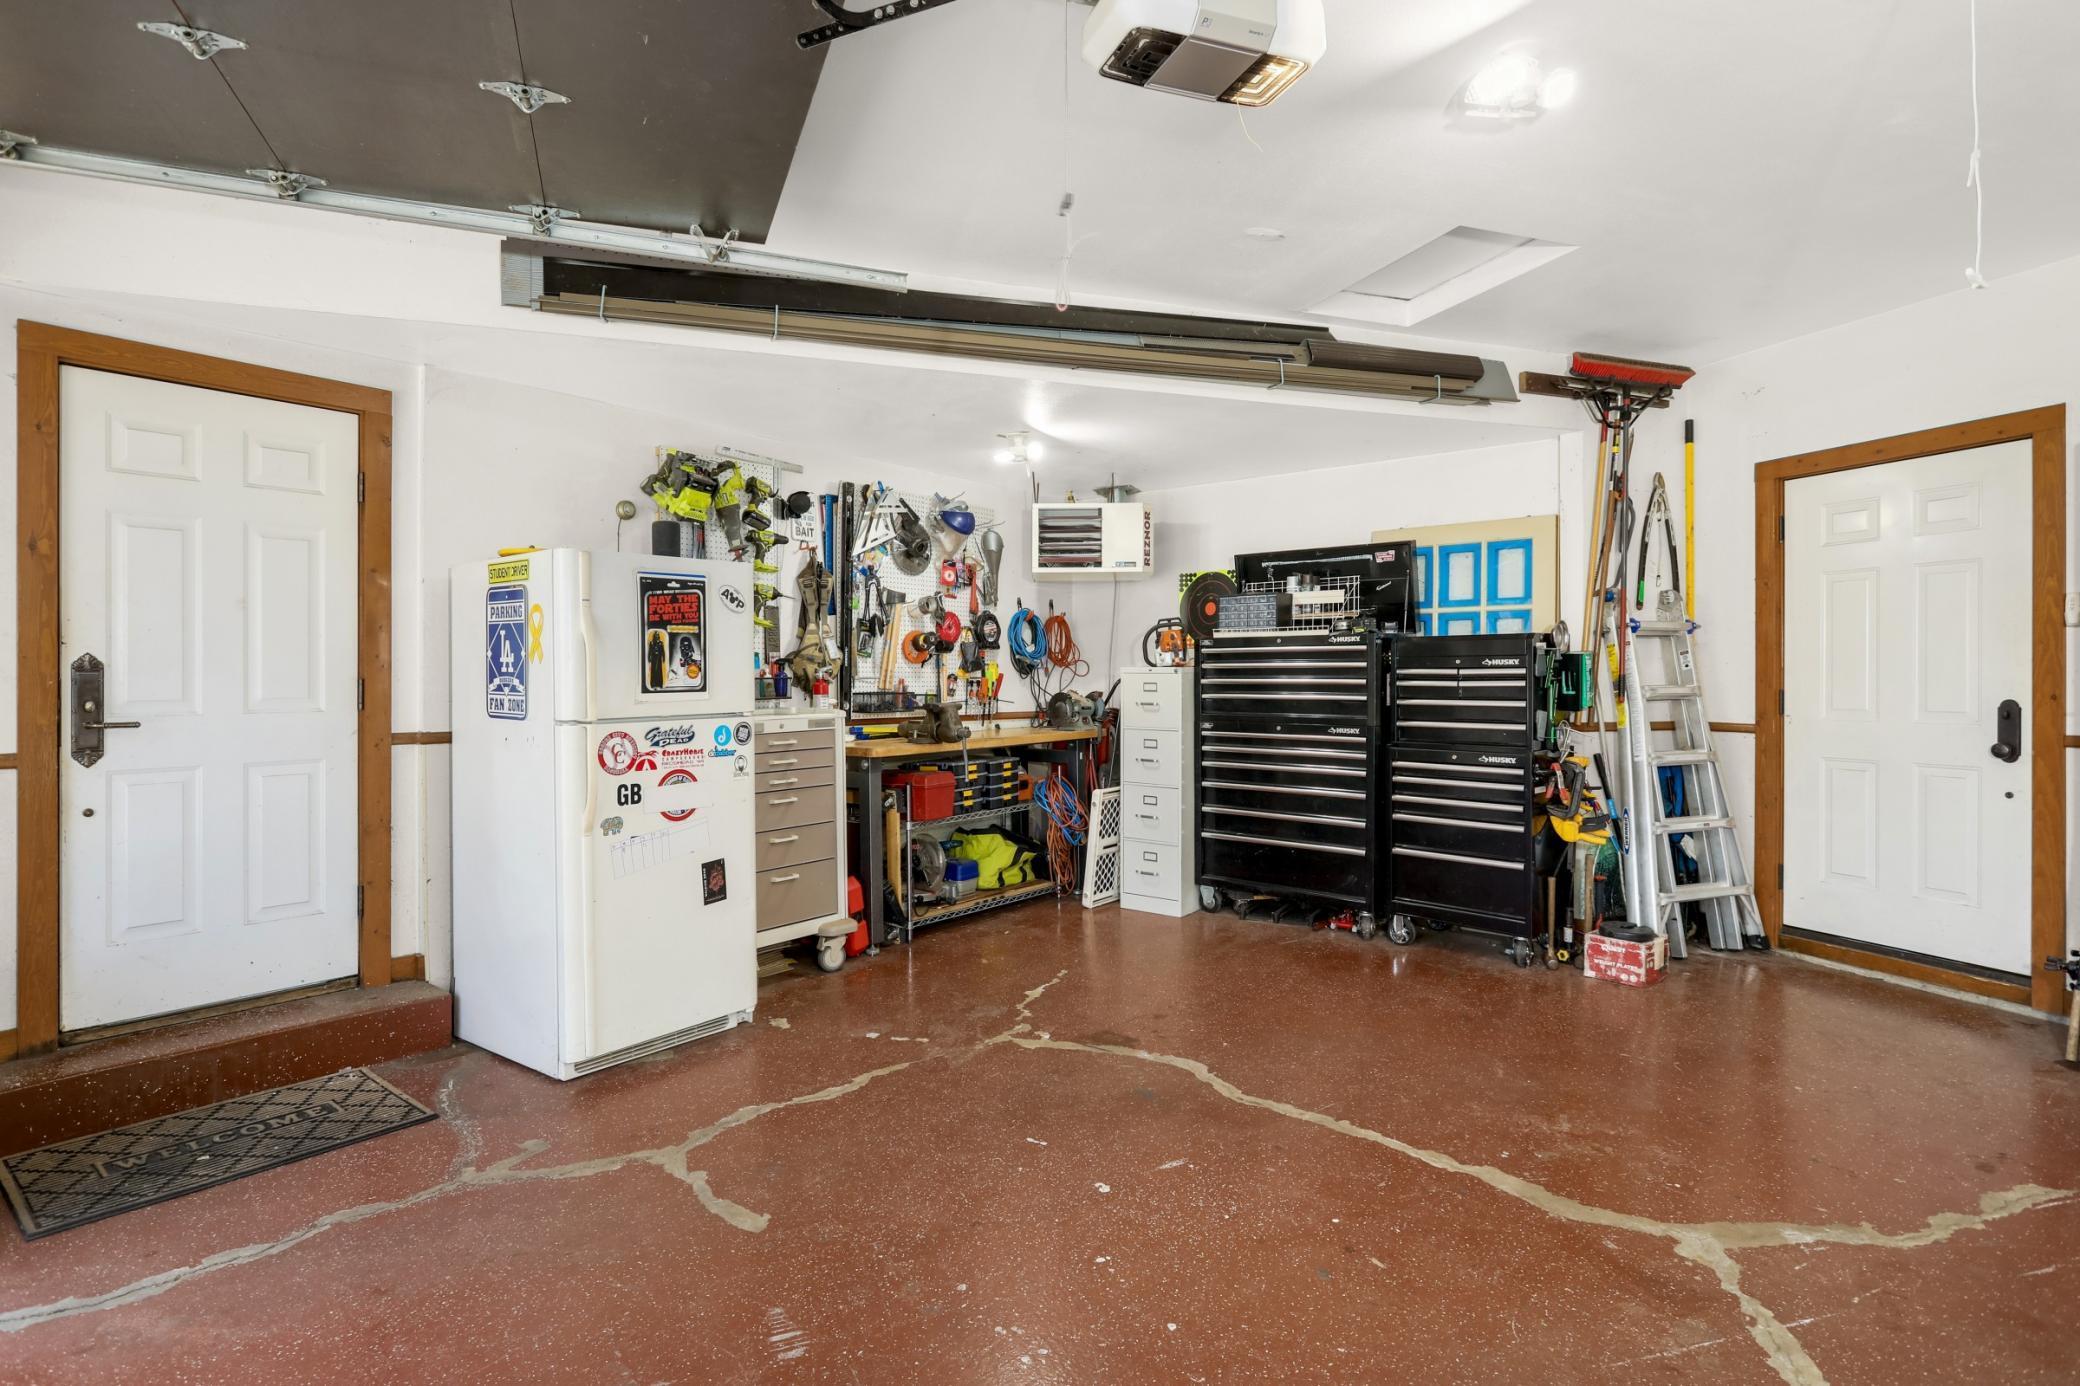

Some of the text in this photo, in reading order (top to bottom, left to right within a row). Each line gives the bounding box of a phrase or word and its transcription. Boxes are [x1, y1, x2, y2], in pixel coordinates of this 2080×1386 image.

[795, 526, 815, 537] BAIT
[1143, 511, 1151, 567] REZNOR
[489, 567, 511, 580] STUDENT
[649, 594, 698, 604] MAY THE
[490, 605, 523, 620] PARKING
[649, 603, 699, 614] FORTIES
[499, 630, 515, 673] LA
[489, 697, 525, 713] FAN ZONE
[645, 724, 695, 743] Grateful
[659, 738, 690, 747] DEAD
[1488, 756, 1517, 764] HUSKY
[617, 783, 642, 807] GB
[114, 1106, 329, 1169] WELCOME
